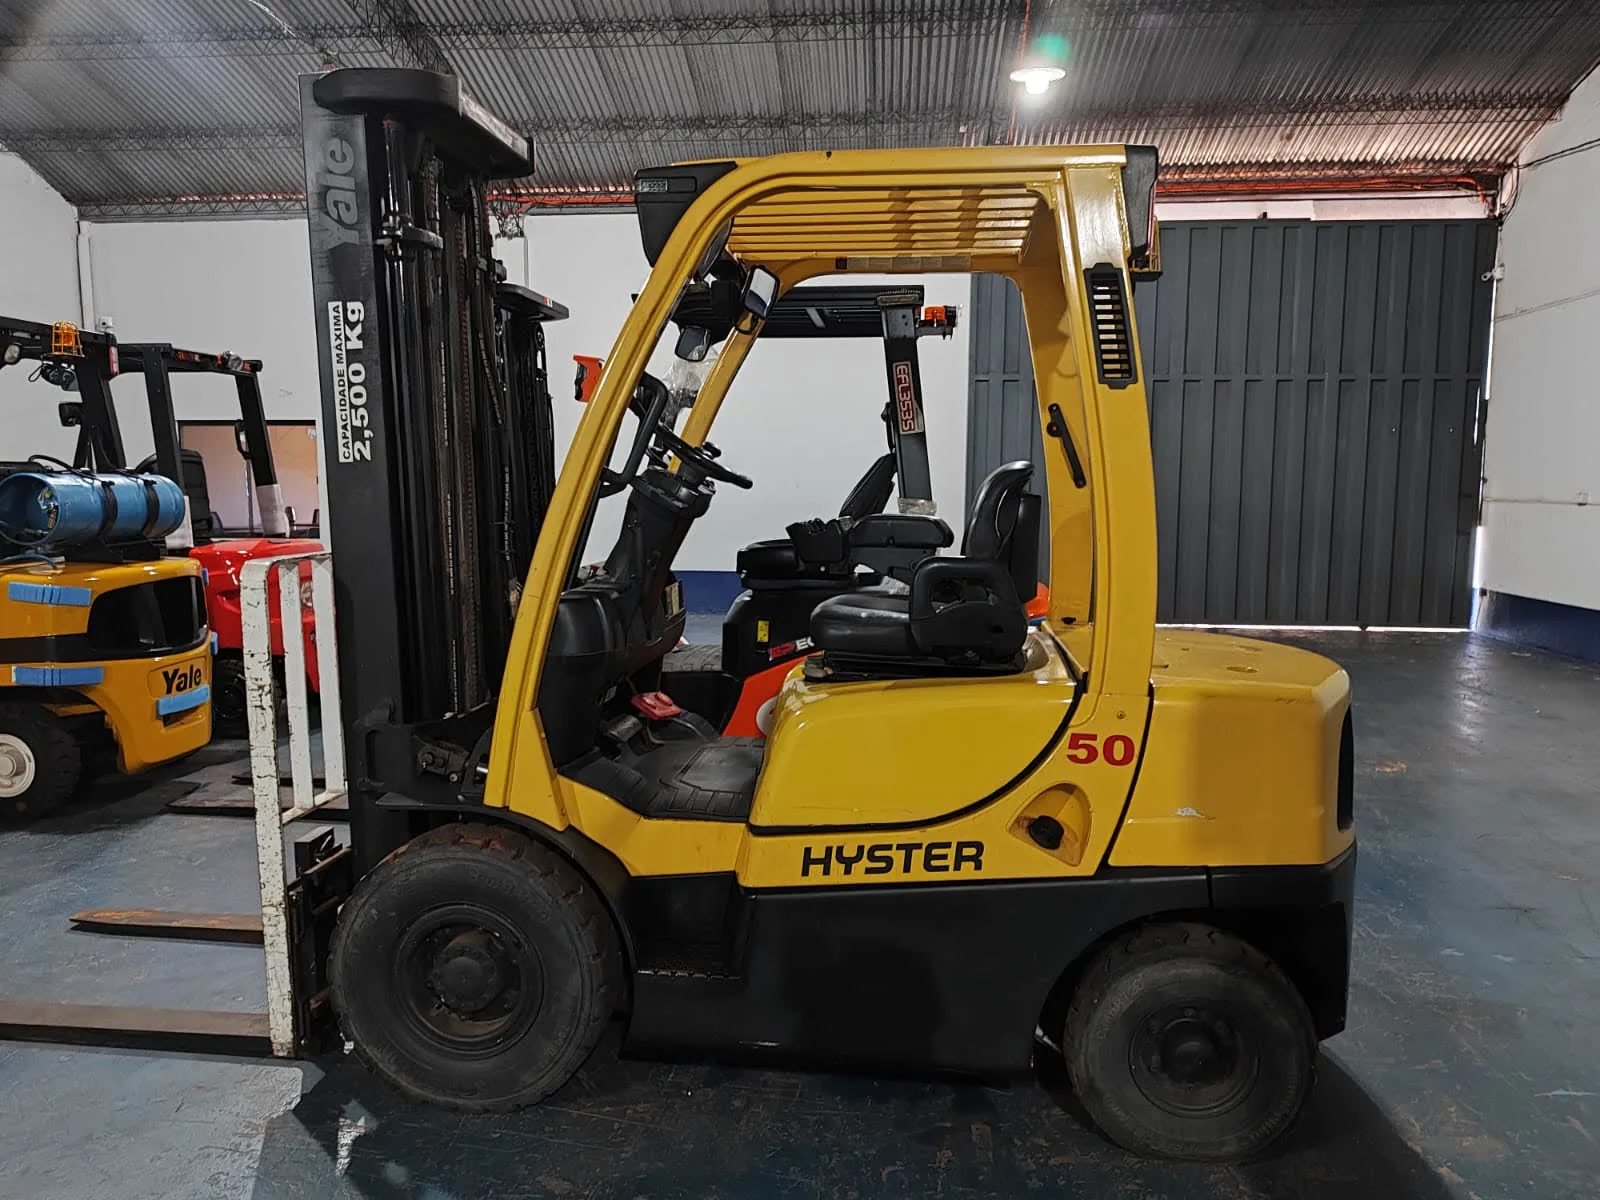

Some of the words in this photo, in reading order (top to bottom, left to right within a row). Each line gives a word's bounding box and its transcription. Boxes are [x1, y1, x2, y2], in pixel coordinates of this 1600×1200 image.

[315, 138, 359, 253] Yale
[331, 305, 345, 365] MÁXIMA
[345, 301, 366, 350] Kg
[336, 368, 351, 460] CAPACIDADE
[347, 362, 374, 462] 2,500
[896, 365, 914, 431] EFL353S
[162, 664, 202, 695] Yale
[1066, 733, 1135, 767] 50
[801, 840, 985, 877] HYSTER
